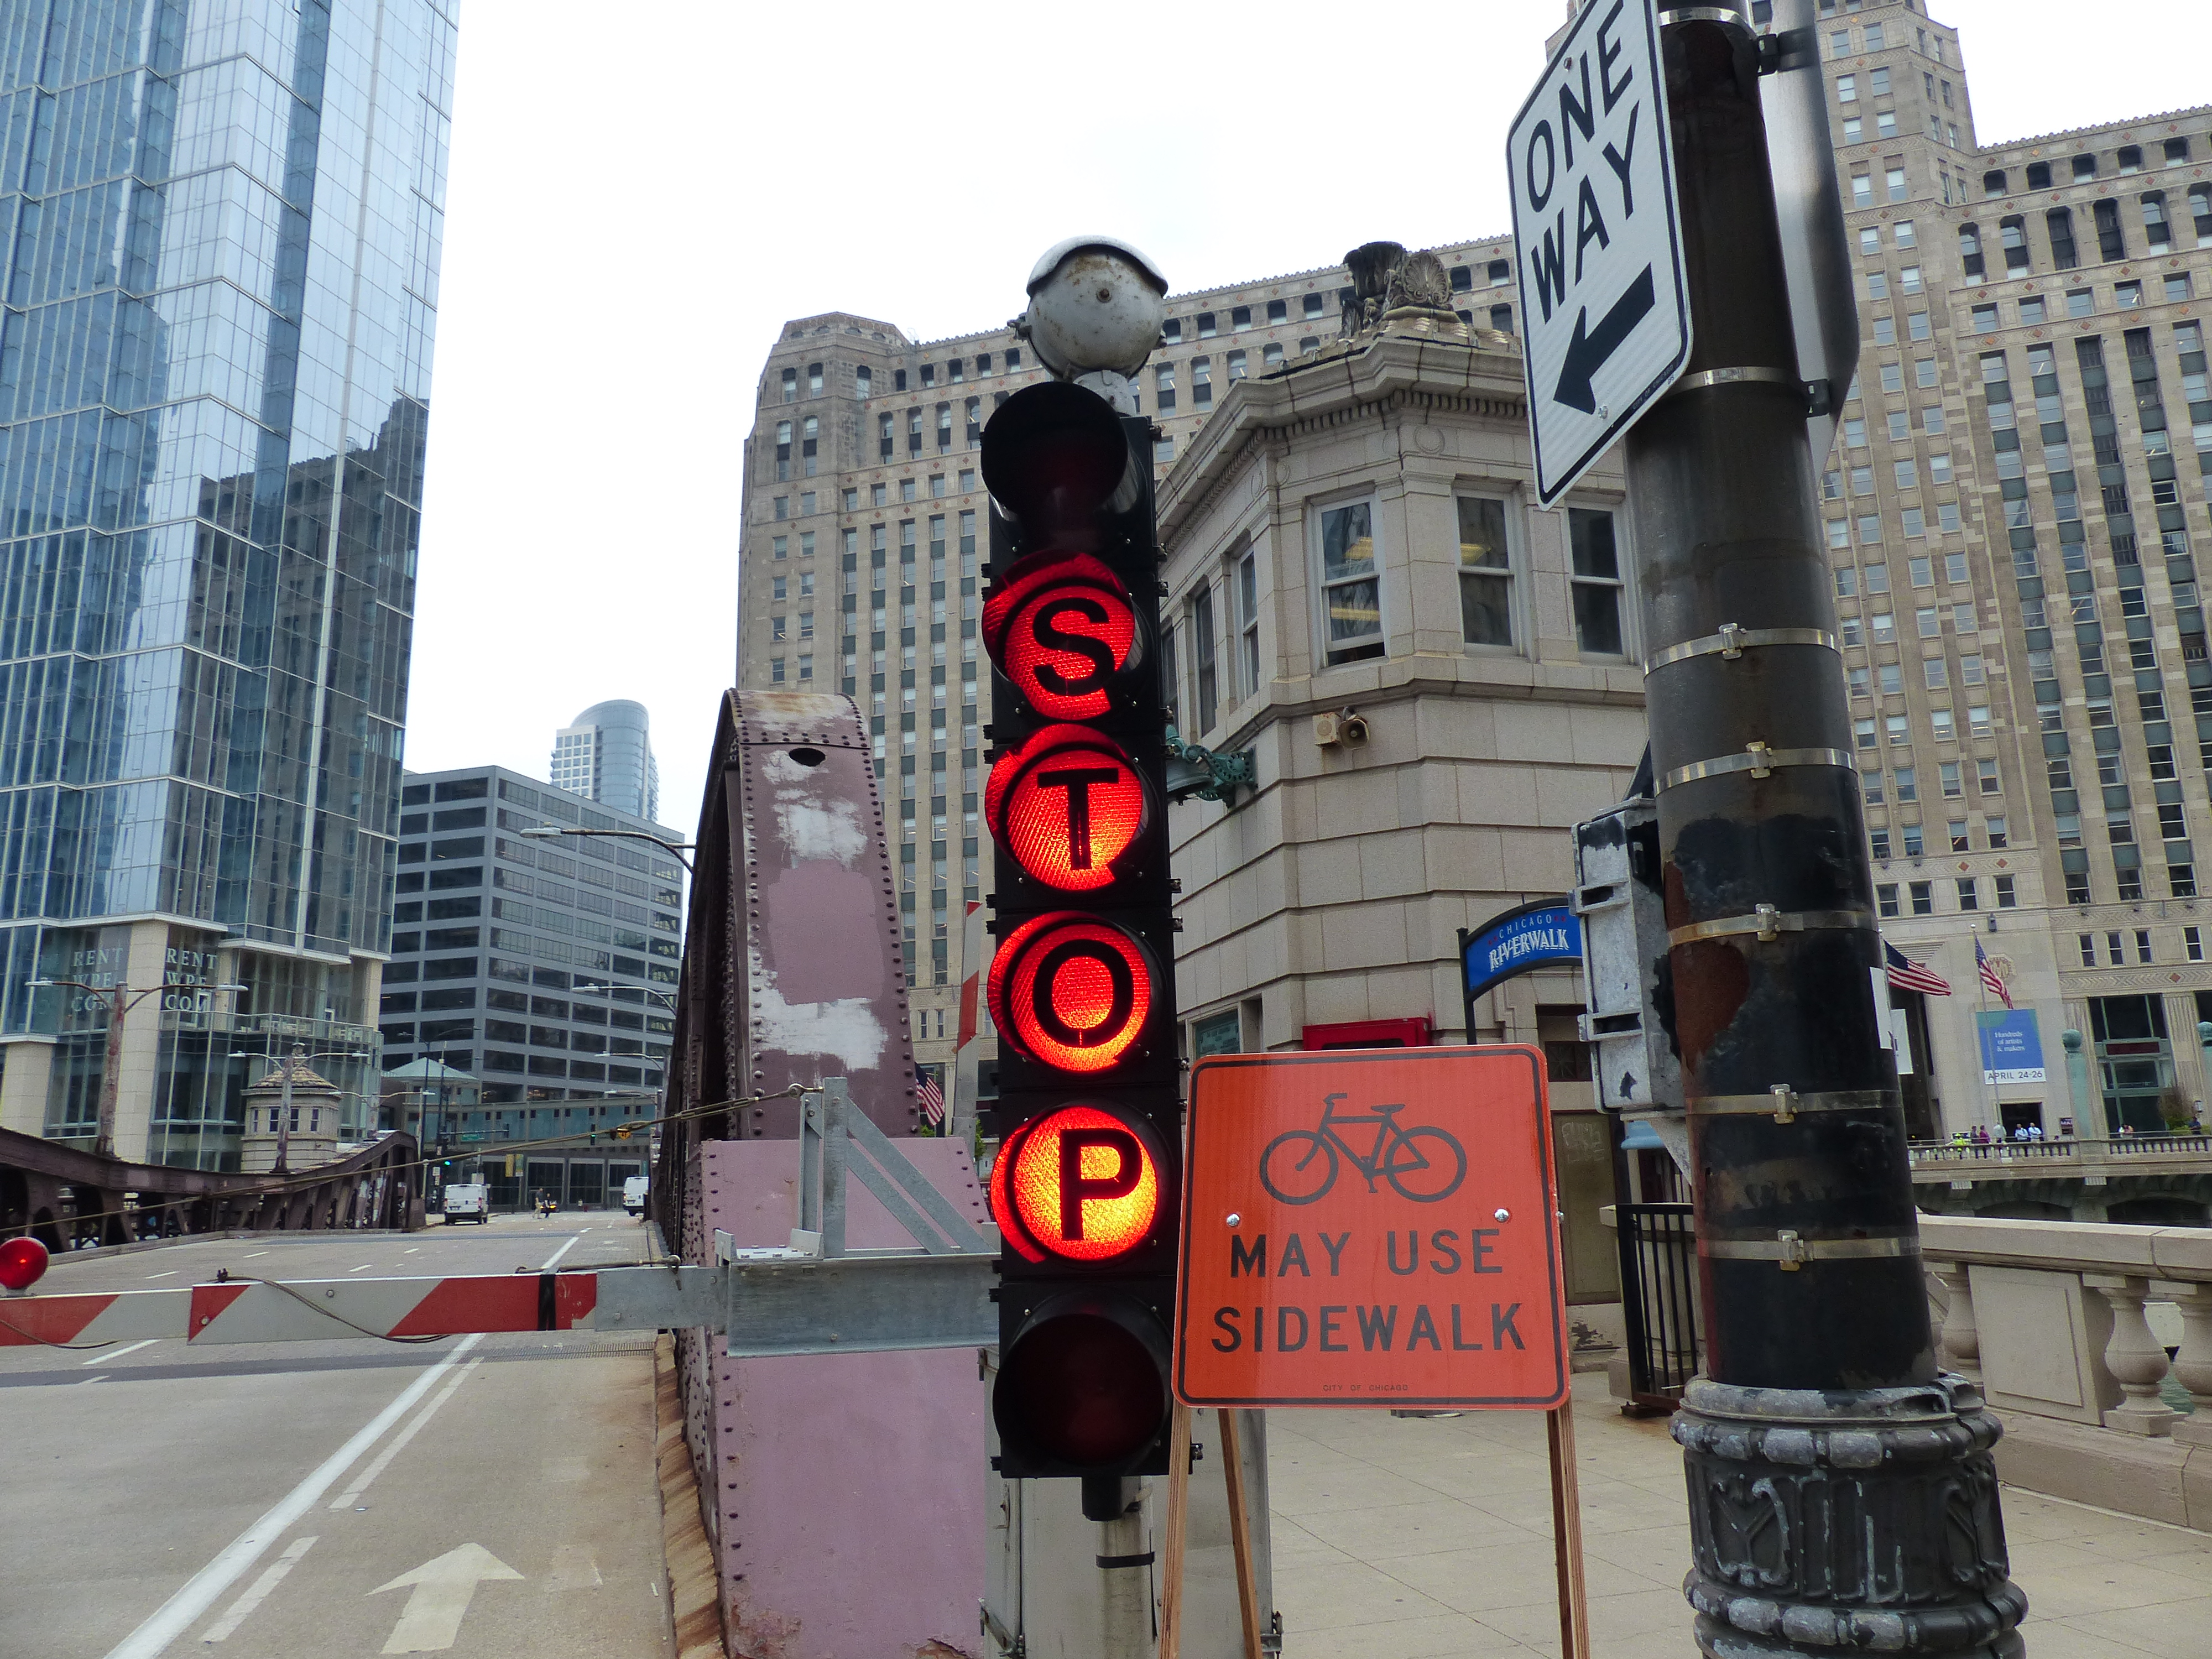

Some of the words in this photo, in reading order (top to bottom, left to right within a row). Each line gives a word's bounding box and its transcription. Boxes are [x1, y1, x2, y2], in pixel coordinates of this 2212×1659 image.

[1527, 0, 1634, 213] ONE
[1531, 100, 1640, 325] WAY
[1499, 914, 1552, 939] CHICAGO
[73, 948, 123, 967] RENT
[166, 947, 217, 969] RENT
[1489, 928, 1570, 972] RIVERWALK
[2018, 1071, 2042, 1079] 24-26
[1230, 1232, 1350, 1277] MAY
[1387, 1228, 1503, 1275] USE
[1211, 1302, 1526, 1353] SIDEWALK
